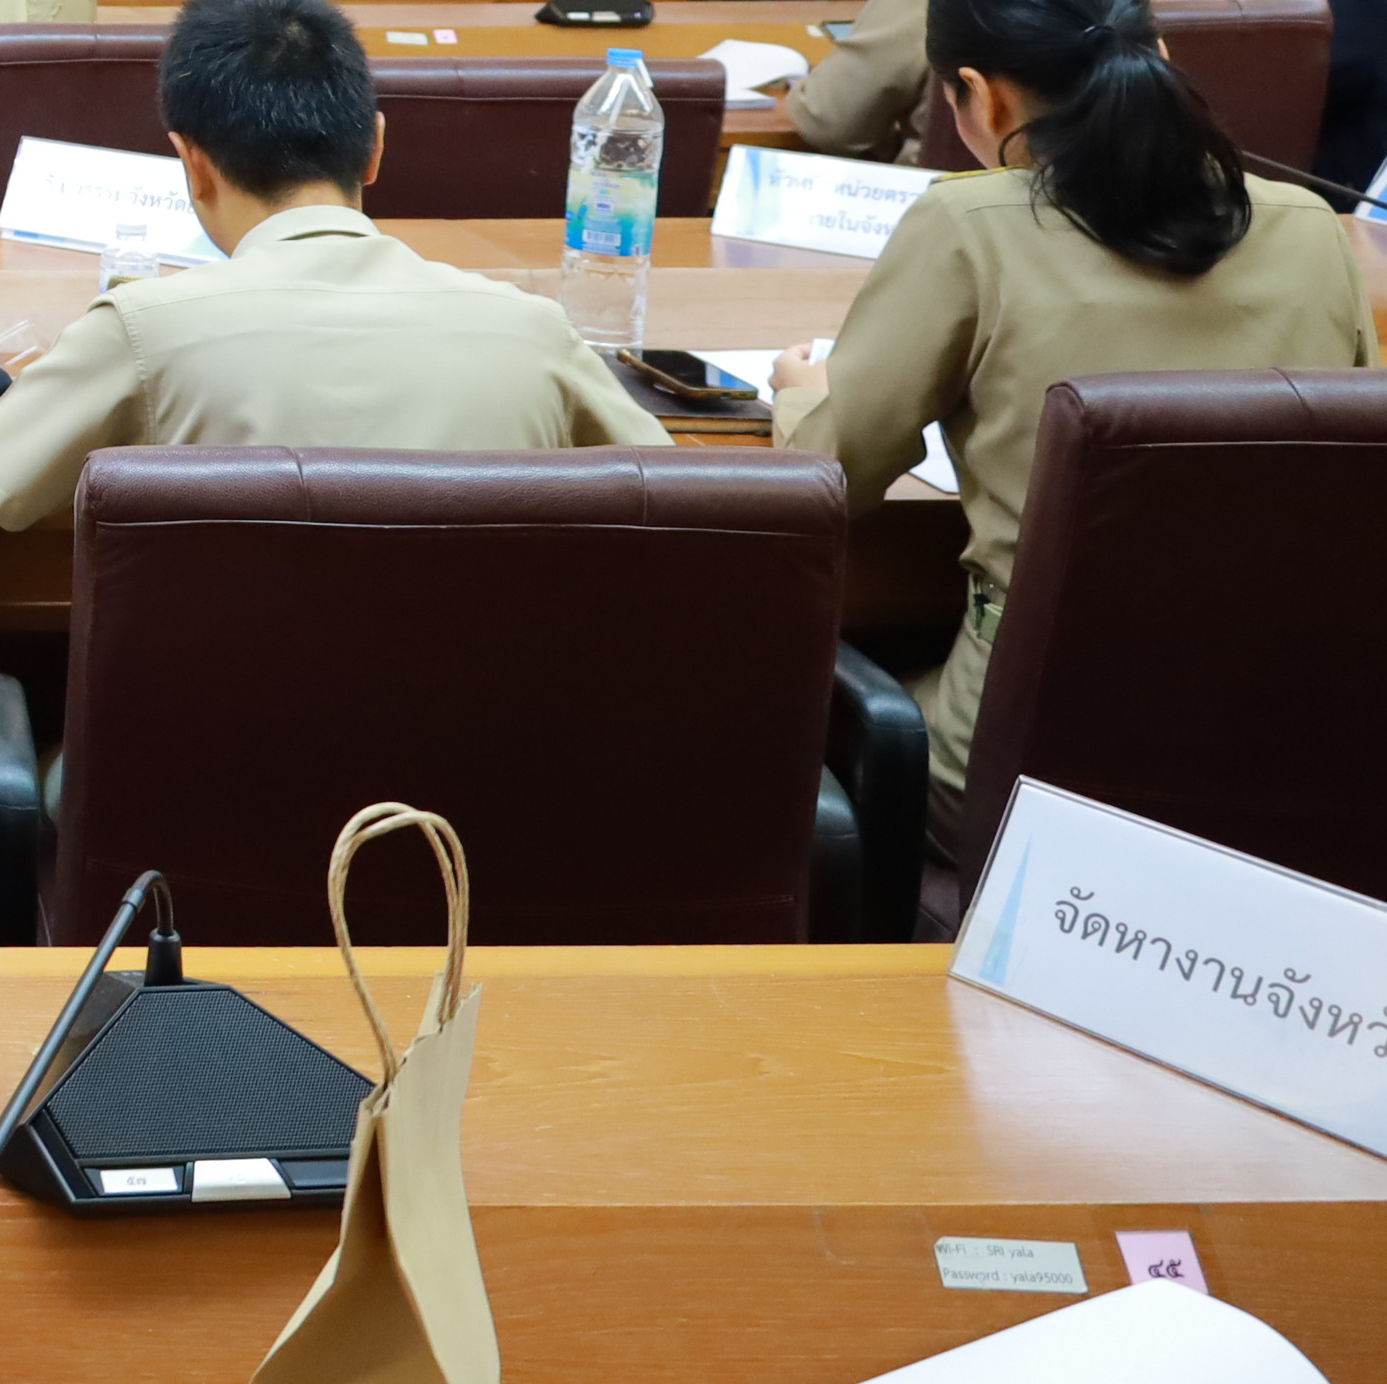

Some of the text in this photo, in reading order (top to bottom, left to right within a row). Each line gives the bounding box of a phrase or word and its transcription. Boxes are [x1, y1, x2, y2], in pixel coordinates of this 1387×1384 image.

[1054, 886, 1387, 1059] จัดหางานจังหว
[936, 1244, 967, 1256] Wi-Fi
[986, 1246, 1005, 1257] SRI
[1010, 1246, 1034, 1260] yala
[943, 1268, 1000, 1282] Password
[1011, 1270, 1074, 1286] yala95000
